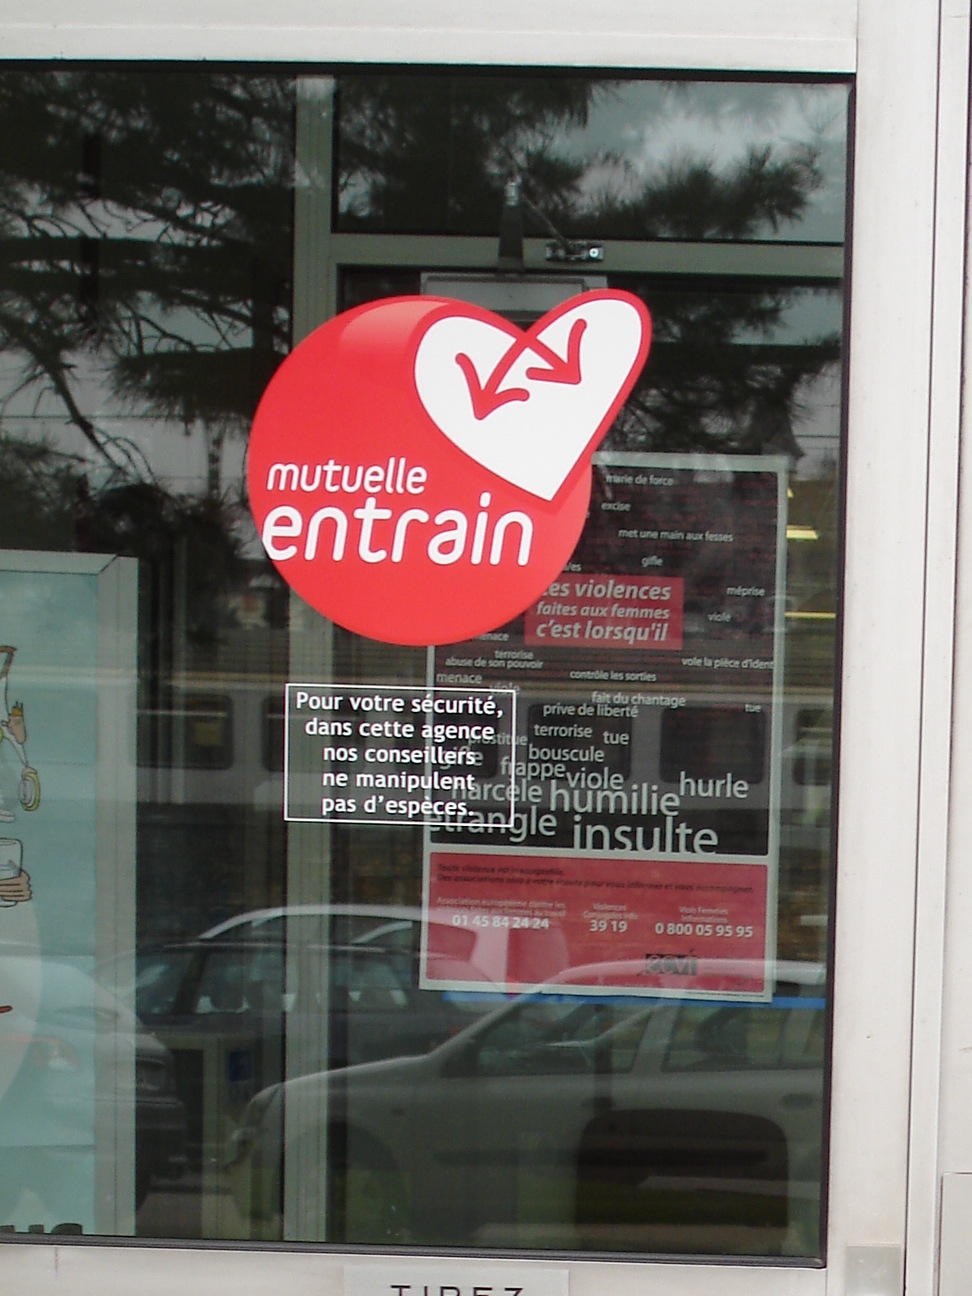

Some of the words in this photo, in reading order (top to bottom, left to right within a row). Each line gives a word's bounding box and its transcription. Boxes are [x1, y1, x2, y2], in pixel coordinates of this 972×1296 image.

[266, 457, 428, 494] mutuelle
[634, 474, 648, 485] de
[261, 491, 534, 567] entrain
[660, 530, 685, 541] main
[685, 532, 703, 542] aux
[641, 555, 664, 567] gifle
[575, 579, 671, 600] violences
[726, 585, 766, 597] méprise
[536, 601, 577, 616] faites
[580, 606, 608, 618] aux
[611, 603, 670, 619] femmes
[536, 620, 581, 638] c'est
[584, 620, 669, 645] lorsqu'il
[445, 656, 473, 667] abuse
[473, 657, 487, 667] de
[487, 660, 505, 668] son
[506, 659, 544, 669] pouvoir
[494, 650, 534, 660] terrorise
[703, 658, 712, 668] la
[436, 673, 482, 684] menace
[569, 670, 609, 681] contrôle
[610, 671, 623, 681] les
[625, 672, 657, 682] sorties
[296, 691, 343, 710] Pour
[350, 694, 405, 713] votre
[411, 693, 503, 719] sécurité,
[591, 691, 611, 704] fait
[613, 692, 629, 704] du
[631, 693, 686, 709] chantage
[744, 703, 761, 712] tue
[543, 702, 574, 717] prive
[577, 703, 595, 716] de
[597, 704, 639, 718] liberté
[305, 717, 352, 736] dans
[358, 720, 415, 737] cette
[421, 725, 495, 743] agence
[534, 724, 593, 738] terrorise
[603, 730, 629, 745] tue
[323, 747, 358, 762] nos
[364, 746, 476, 765] conseillers
[528, 743, 605, 763] bouscule
[500, 756, 566, 782] frappe
[323, 772, 348, 787] ne
[356, 770, 475, 793] manipulent
[566, 767, 624, 790] viole
[680, 771, 749, 799] hurle
[550, 779, 680, 816] humilie
[322, 798, 356, 815] pas
[363, 796, 474, 818] d'espèces.
[573, 815, 718, 854] insulte
[452, 914, 468, 926] 01
[472, 916, 489, 927] 45
[492, 917, 510, 928] 84
[512, 918, 530, 929] 24
[532, 918, 549, 929] 24
[589, 919, 607, 932] 39
[611, 920, 628, 932] 19
[655, 922, 664, 934] 0
[667, 923, 692, 935] 800
[695, 924, 713, 936] 05
[716, 925, 733, 937] 95
[736, 926, 753, 938] 95
